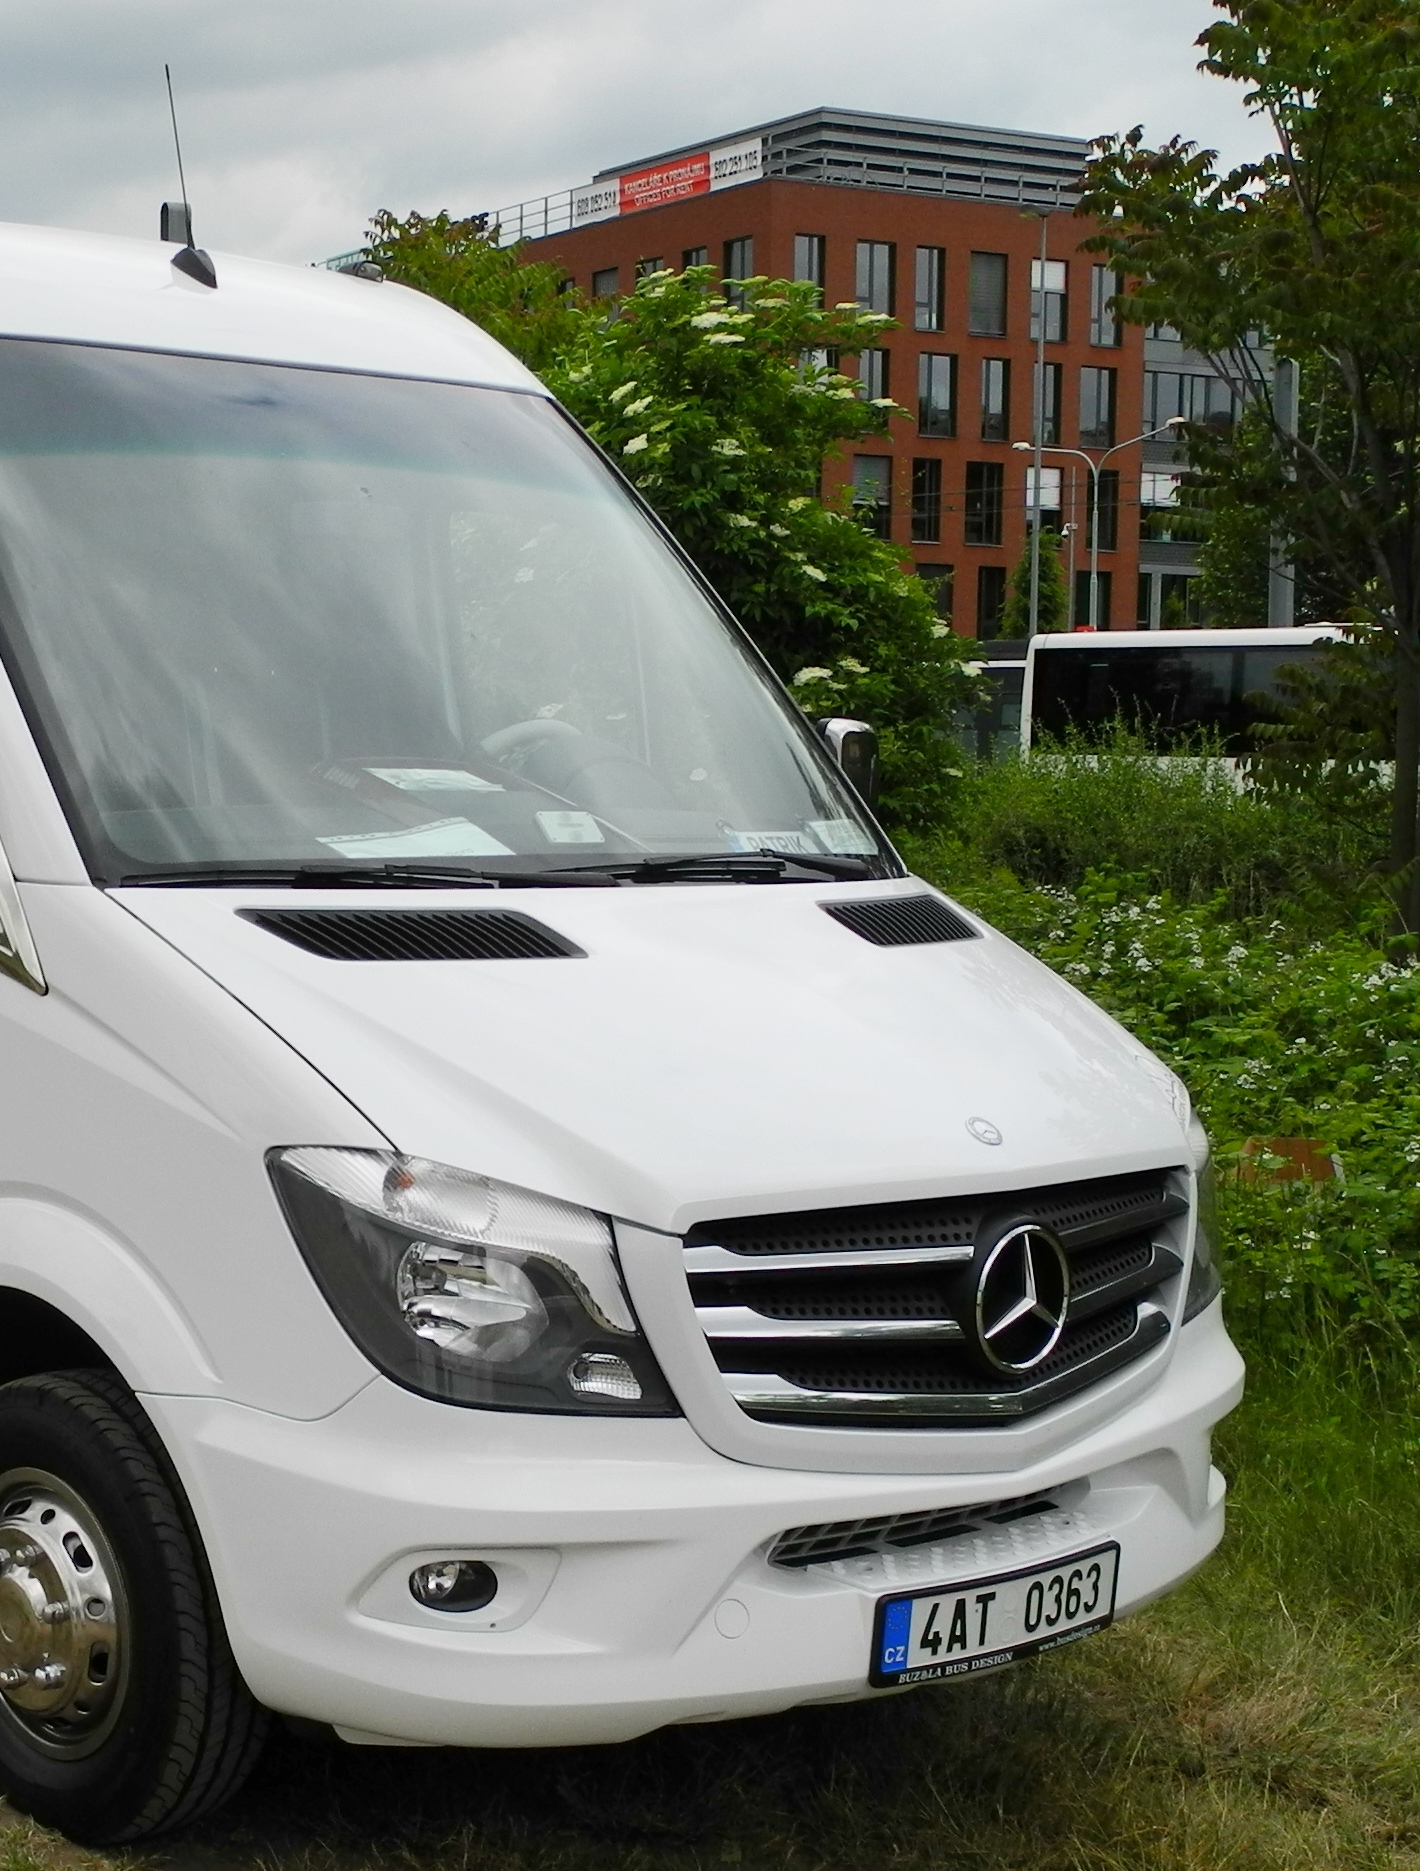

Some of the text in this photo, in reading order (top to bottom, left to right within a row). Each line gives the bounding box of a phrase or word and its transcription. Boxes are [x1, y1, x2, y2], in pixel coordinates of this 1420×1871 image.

[662, 185, 676, 199] FOR
[676, 180, 694, 195] RENT
[745, 836, 810, 854] PATRIK
[920, 1562, 1101, 1656] 4AT 0363
[884, 1646, 905, 1664] CZ
[945, 1662, 969, 1676] BUS
[971, 1652, 1013, 1671] DESIGN
